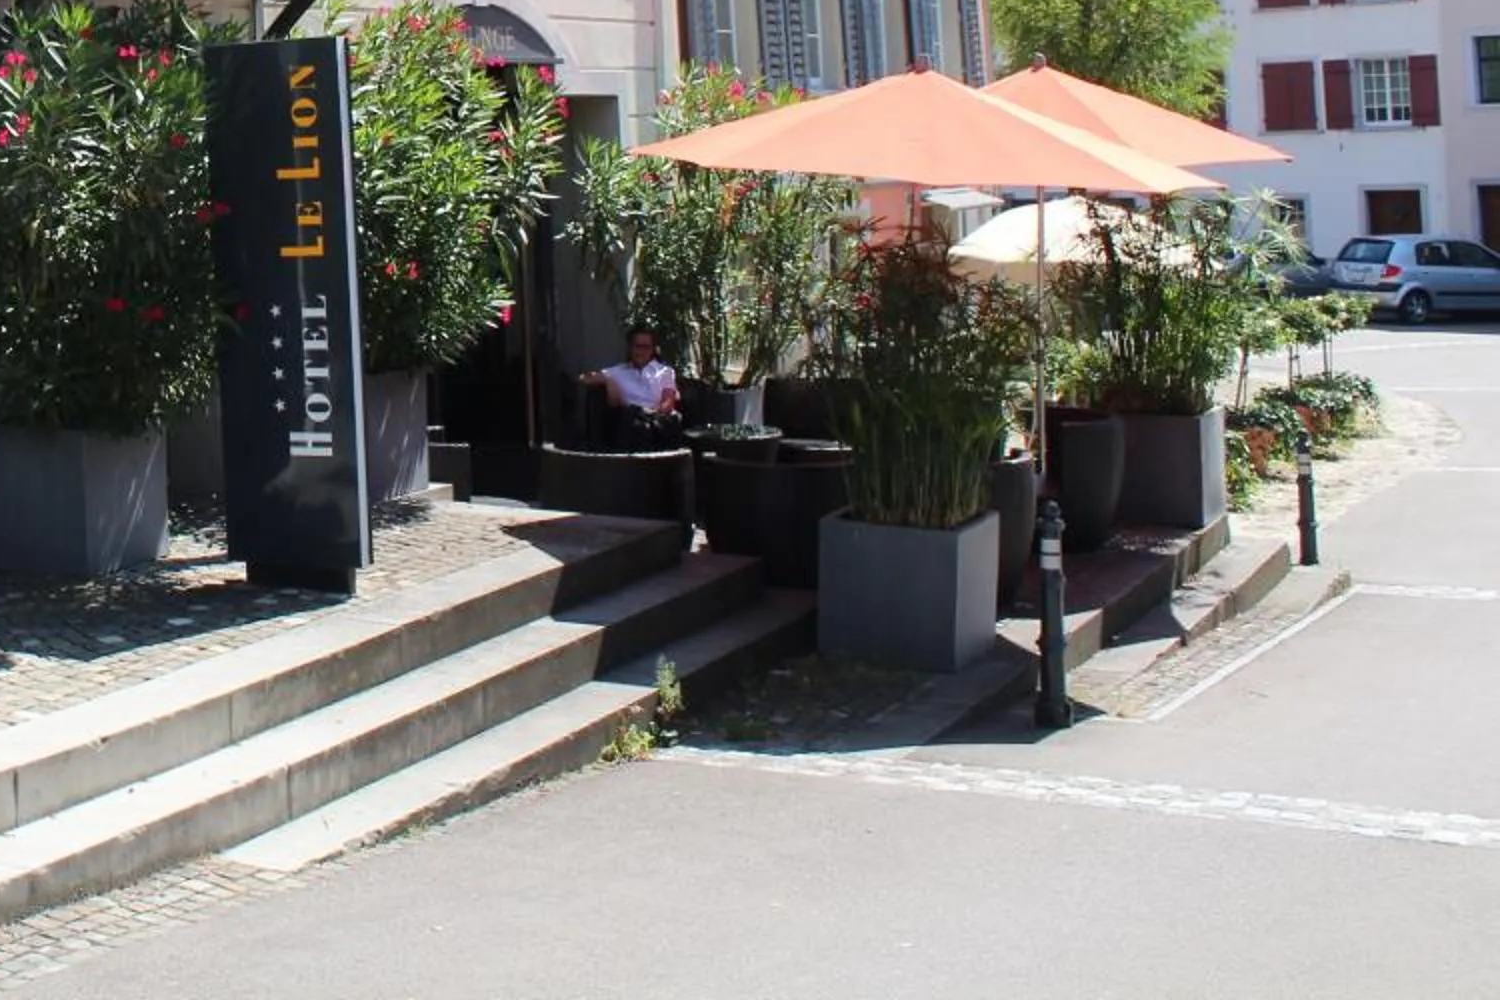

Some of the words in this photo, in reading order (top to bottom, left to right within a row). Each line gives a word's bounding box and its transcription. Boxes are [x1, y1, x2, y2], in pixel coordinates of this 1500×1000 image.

[275, 65, 321, 181] LION
[281, 201, 325, 258] LE
[289, 294, 334, 457] HOTEL
